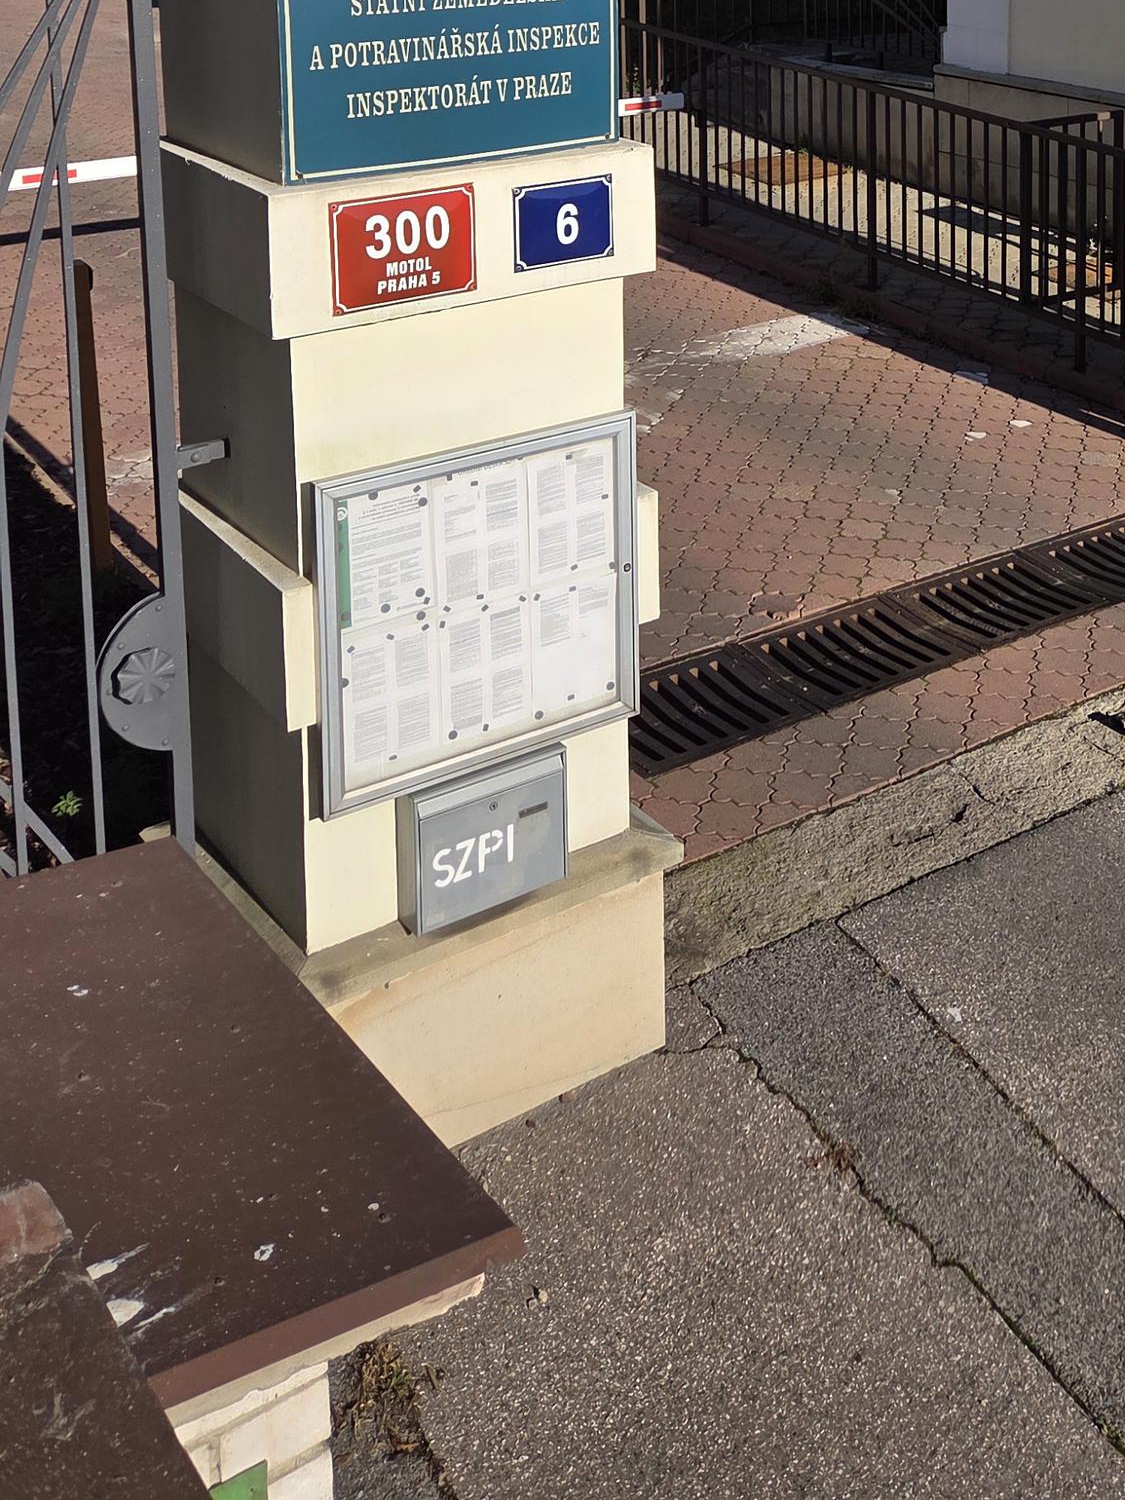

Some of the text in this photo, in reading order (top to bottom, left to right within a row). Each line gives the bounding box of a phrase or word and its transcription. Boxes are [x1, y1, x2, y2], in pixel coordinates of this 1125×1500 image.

[309, 21, 601, 71] A POTRAVINÁŘSKÁ INSPEKCE
[346, 71, 573, 119] INSPEKTORÁT V PRAZE
[364, 204, 451, 260] 300
[555, 202, 580, 245] 6
[377, 271, 441, 295] PRAHA 5
[386, 256, 433, 277] MOTOL
[431, 823, 515, 888] SZPI
